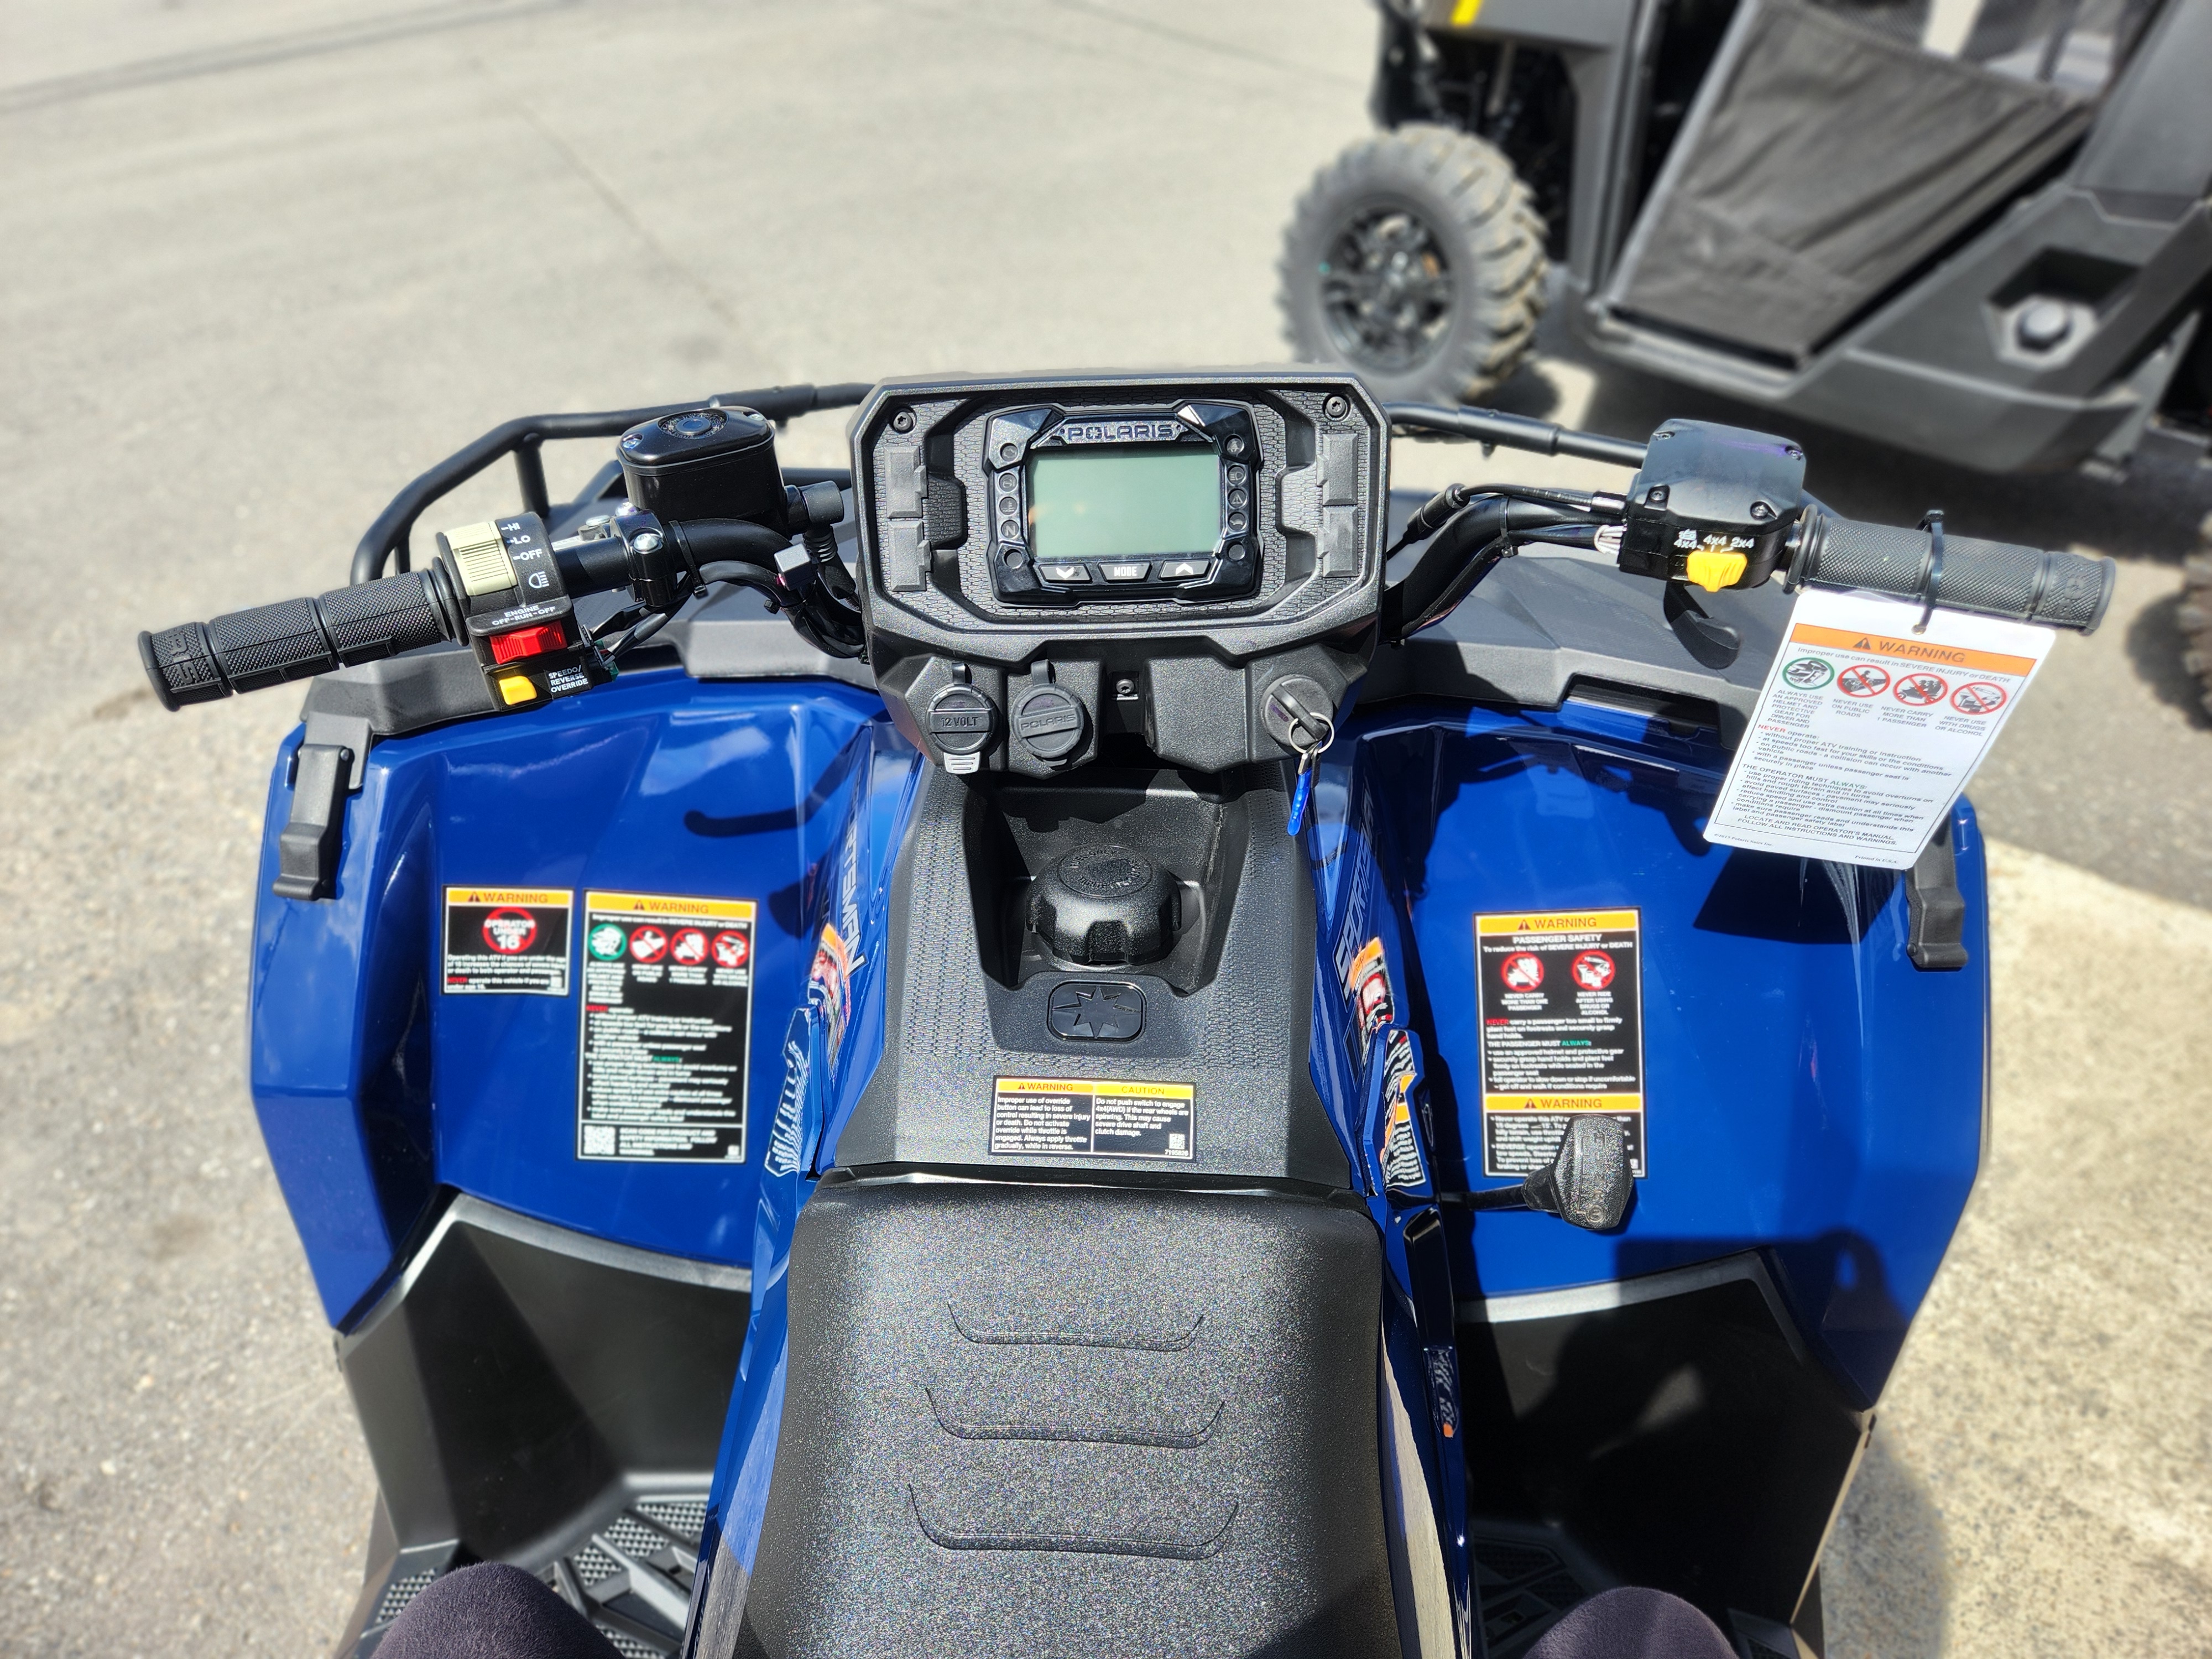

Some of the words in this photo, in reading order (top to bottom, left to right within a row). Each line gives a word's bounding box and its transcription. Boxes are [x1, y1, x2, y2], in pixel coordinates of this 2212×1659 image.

[1068, 424, 1173, 440] POLARIS
[508, 522, 521, 531] HI
[513, 535, 531, 545] LO
[1673, 539, 1698, 550] 4x4
[1703, 534, 1728, 546] 4x4
[1730, 536, 1755, 549] 2x4
[520, 549, 542, 561] OFF
[1114, 566, 1138, 577] MODE
[504, 605, 540, 618] ENGINE
[1879, 640, 1965, 663] WARNING
[1797, 647, 1835, 657] Improper
[1899, 662, 1936, 672] SEVERE
[1935, 667, 1969, 677] INJURY
[1978, 674, 2011, 683] DEATH
[549, 664, 582, 679] SPEEDO/
[550, 672, 585, 686] REVERSE
[551, 678, 589, 693] OVERRIDE
[1777, 690, 1808, 698] ALWAYS
[1773, 699, 1802, 707] HELMET
[1783, 696, 1823, 706] APPROVED
[1771, 703, 1815, 714] PROTECTIVE
[1835, 709, 1861, 718] ROADS
[1843, 706, 1870, 714] PUBLIC
[941, 717, 952, 728] 12
[954, 717, 979, 727] VOLT
[1020, 714, 1076, 732] POLARIS
[1767, 717, 1810, 729] PASSENGER
[1882, 717, 1927, 728] PASSENGER
[1757, 724, 1786, 733] NEVER
[1787, 731, 1819, 740] operate:
[1947, 727, 1983, 737] ALCOHOL
[1765, 732, 1793, 741] without
[1838, 744, 1868, 754] training
[1879, 751, 1921, 762] instruction
[1759, 767, 1804, 780] OPERATOR
[1829, 780, 1867, 790] ALWAYS:
[1737, 818, 1768, 827] FOLLOW
[1784, 826, 1838, 837] INSTRUCTIONS
[1856, 836, 1897, 846] WARNINGS.
[1744, 815, 1773, 823] LOCATE
[1813, 826, 1861, 836] OPERATOR'S
[1861, 832, 1894, 841] MANUAL.
[483, 893, 548, 904] WARNING
[649, 901, 709, 914] WARNING
[1533, 917, 1597, 929] WARNING
[497, 935, 520, 950] 16
[1513, 935, 1567, 944] PASSENGER
[1567, 933, 1602, 942] SAFETY
[1027, 1083, 1073, 1091] WARNING
[1121, 1086, 1164, 1095] CAUTION
[997, 1096, 1026, 1104] Improper
[1540, 1098, 1602, 1109] WARNING
[1095, 1105, 1126, 1114] 4x4(AWD)
[1018, 1112, 1045, 1120] resulting
[1073, 1113, 1091, 1121] injury
[1095, 1113, 1123, 1121] spinning.
[994, 1134, 1024, 1142] engaged.
[1046, 1135, 1065, 1144] apply
[1114, 1129, 1142, 1138] damage.
[994, 1141, 1024, 1150] gradually,
